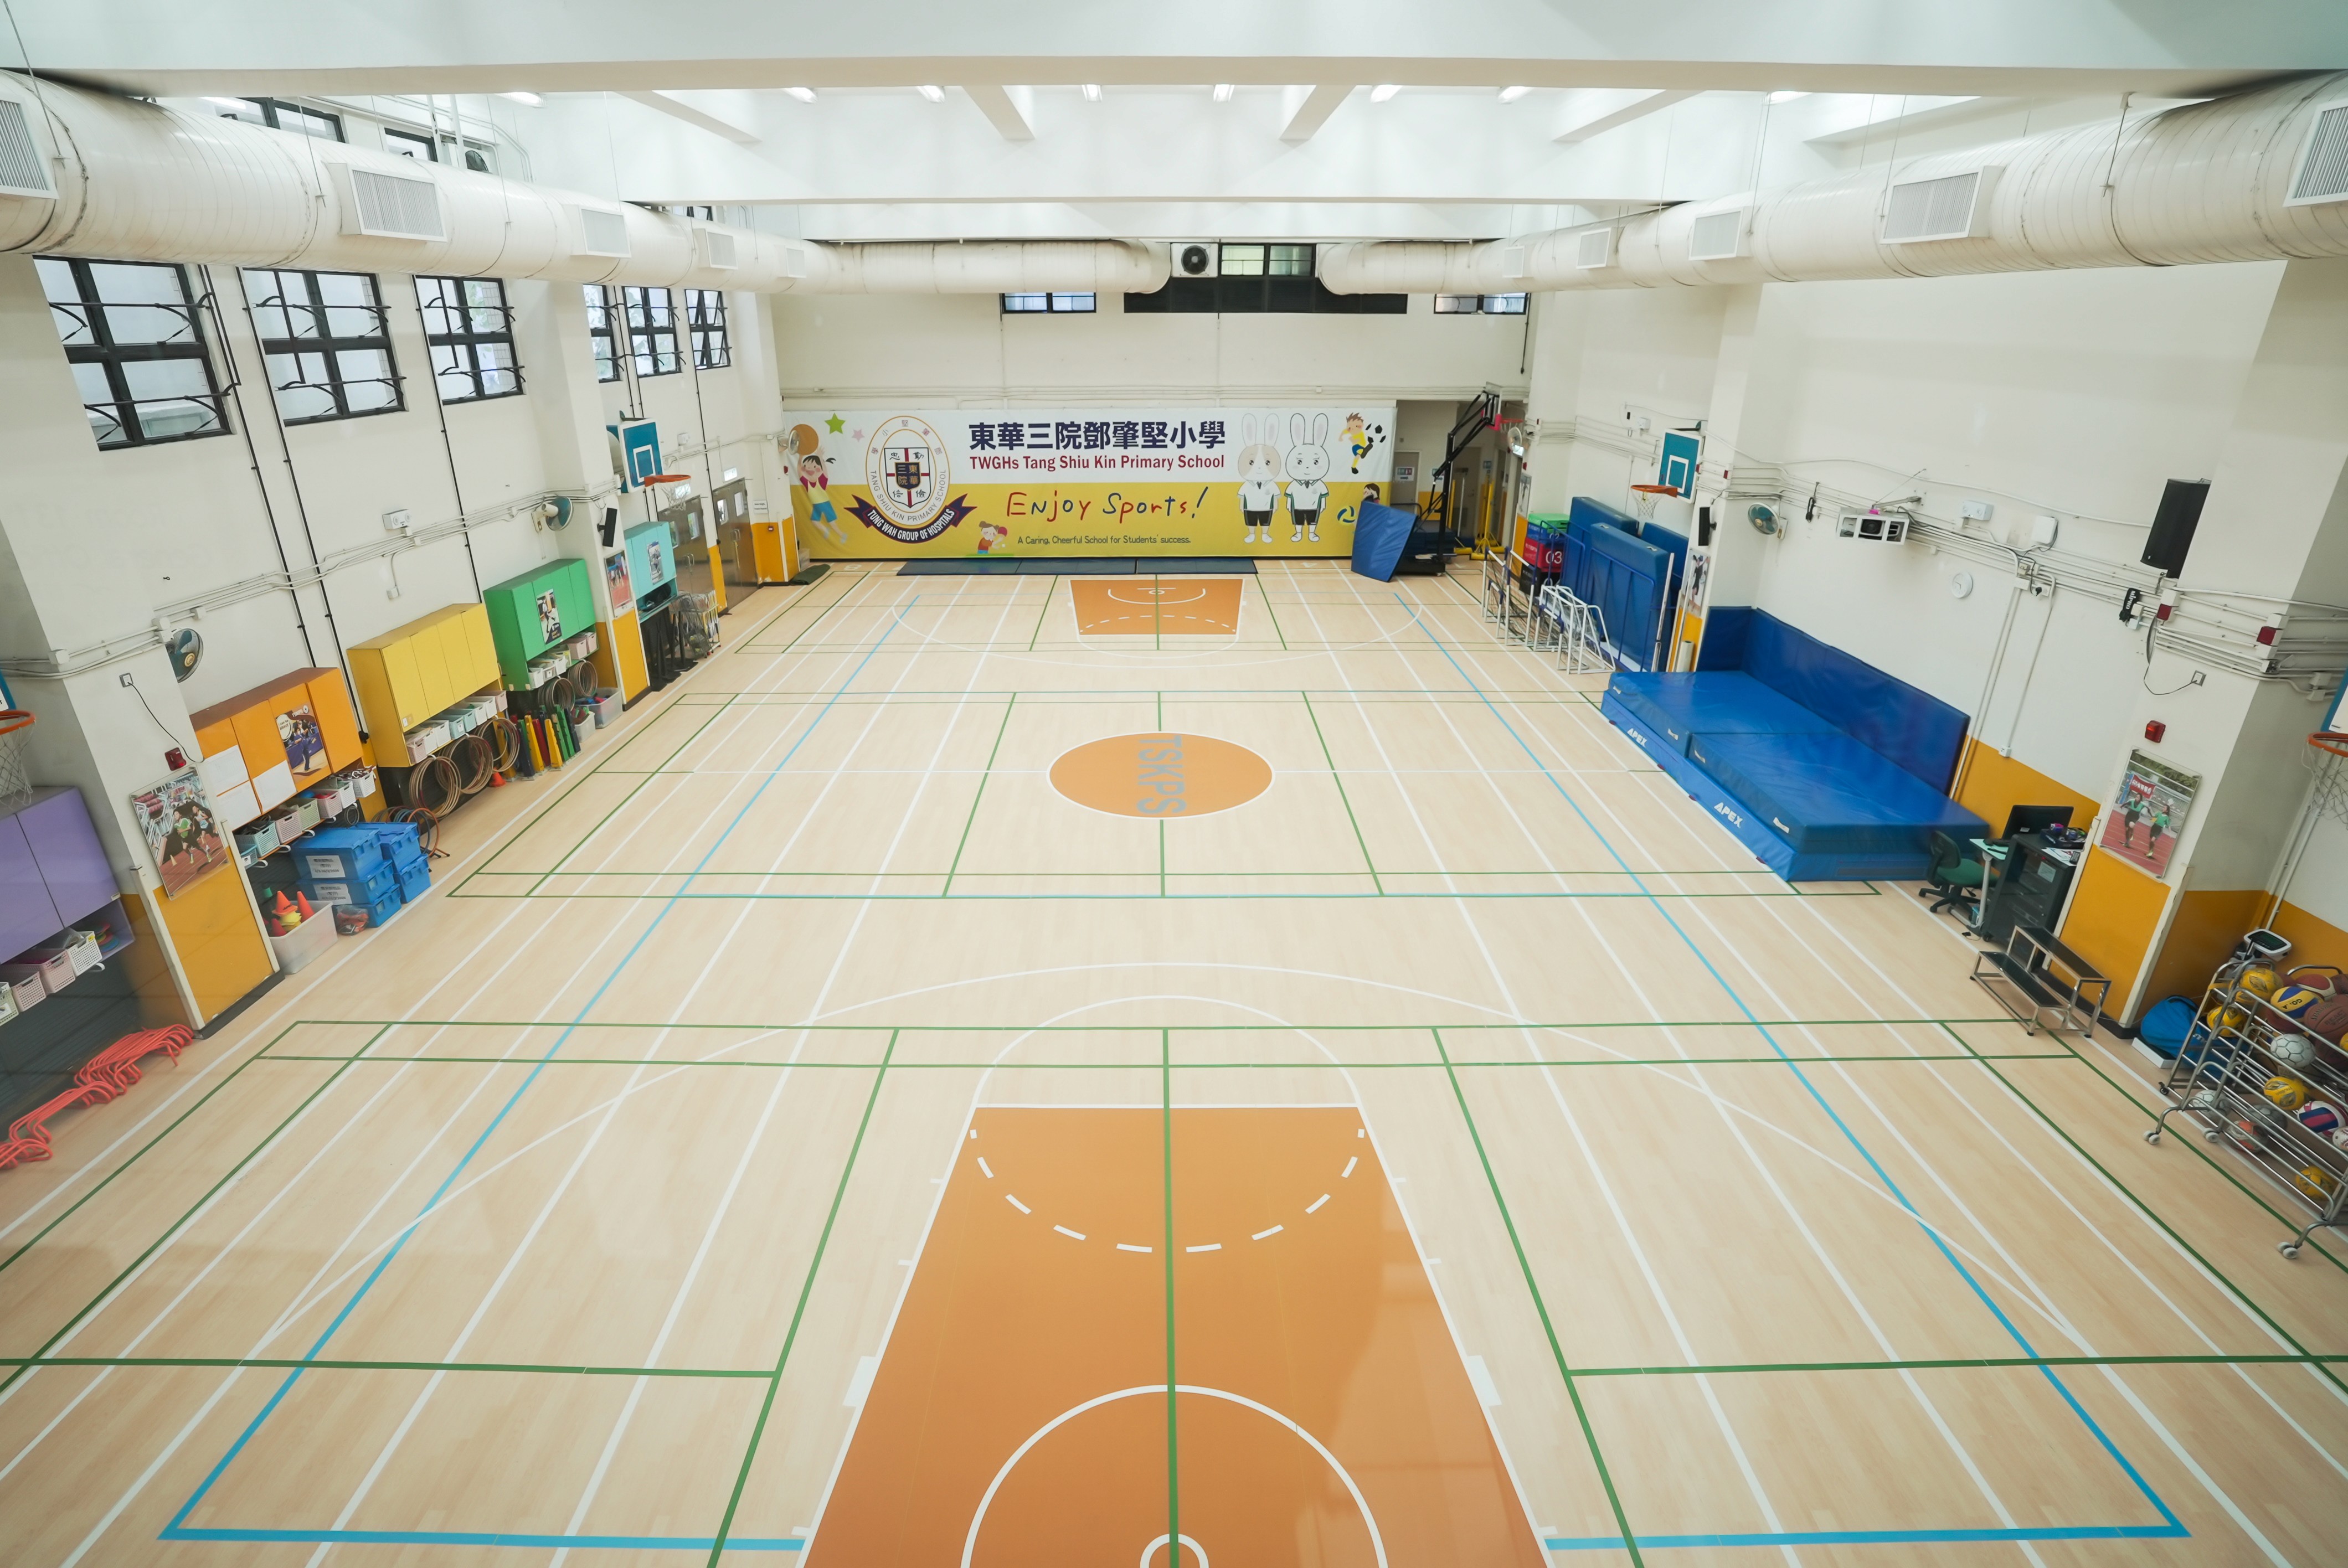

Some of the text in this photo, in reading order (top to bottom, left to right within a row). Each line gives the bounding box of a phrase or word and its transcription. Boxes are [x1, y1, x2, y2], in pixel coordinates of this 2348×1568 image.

[969, 421, 1226, 450] 東華三院鄧肇堅小學
[969, 454, 1224, 472] TWGHs Tang Shiu Kin Primary School
[870, 470, 946, 522] TANG SHIU KIN PRIMARY SCHOOL
[1103, 486, 1209, 524] Sports!
[867, 508, 955, 541] TUNG WAH GROUP OF HOSPITALS
[1017, 536, 1023, 544] A
[1025, 536, 1050, 545] Caring,
[1052, 535, 1083, 544] Cheerful
[1084, 535, 1108, 544] School
[1110, 535, 1120, 544] for
[1546, 550, 1562, 564] 03
[1626, 728, 1647, 748] APEX
[1136, 735, 1187, 815] TSKPS
[1713, 802, 1743, 829] APEX
